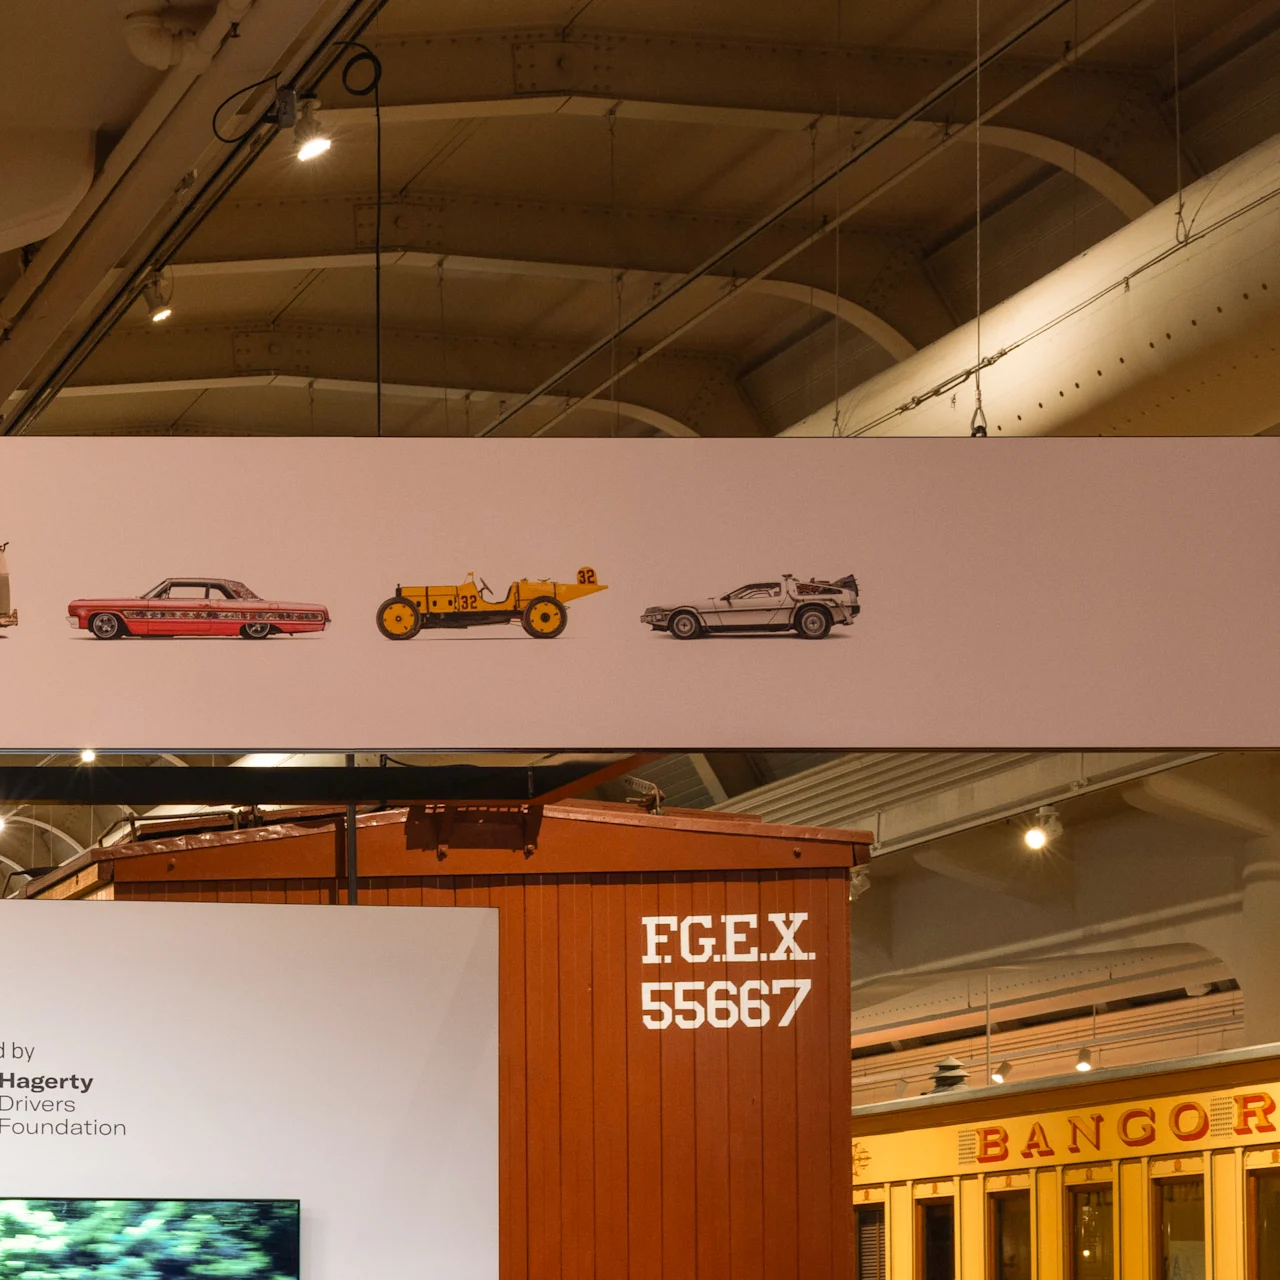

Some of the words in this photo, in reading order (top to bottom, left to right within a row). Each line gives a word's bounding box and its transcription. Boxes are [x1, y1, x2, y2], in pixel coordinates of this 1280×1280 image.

[577, 569, 595, 585] 32
[461, 595, 478, 610] 32
[641, 978, 813, 1030] 55667
[12, 1041, 35, 1063] by
[975, 1091, 1277, 1164] BANGOR
